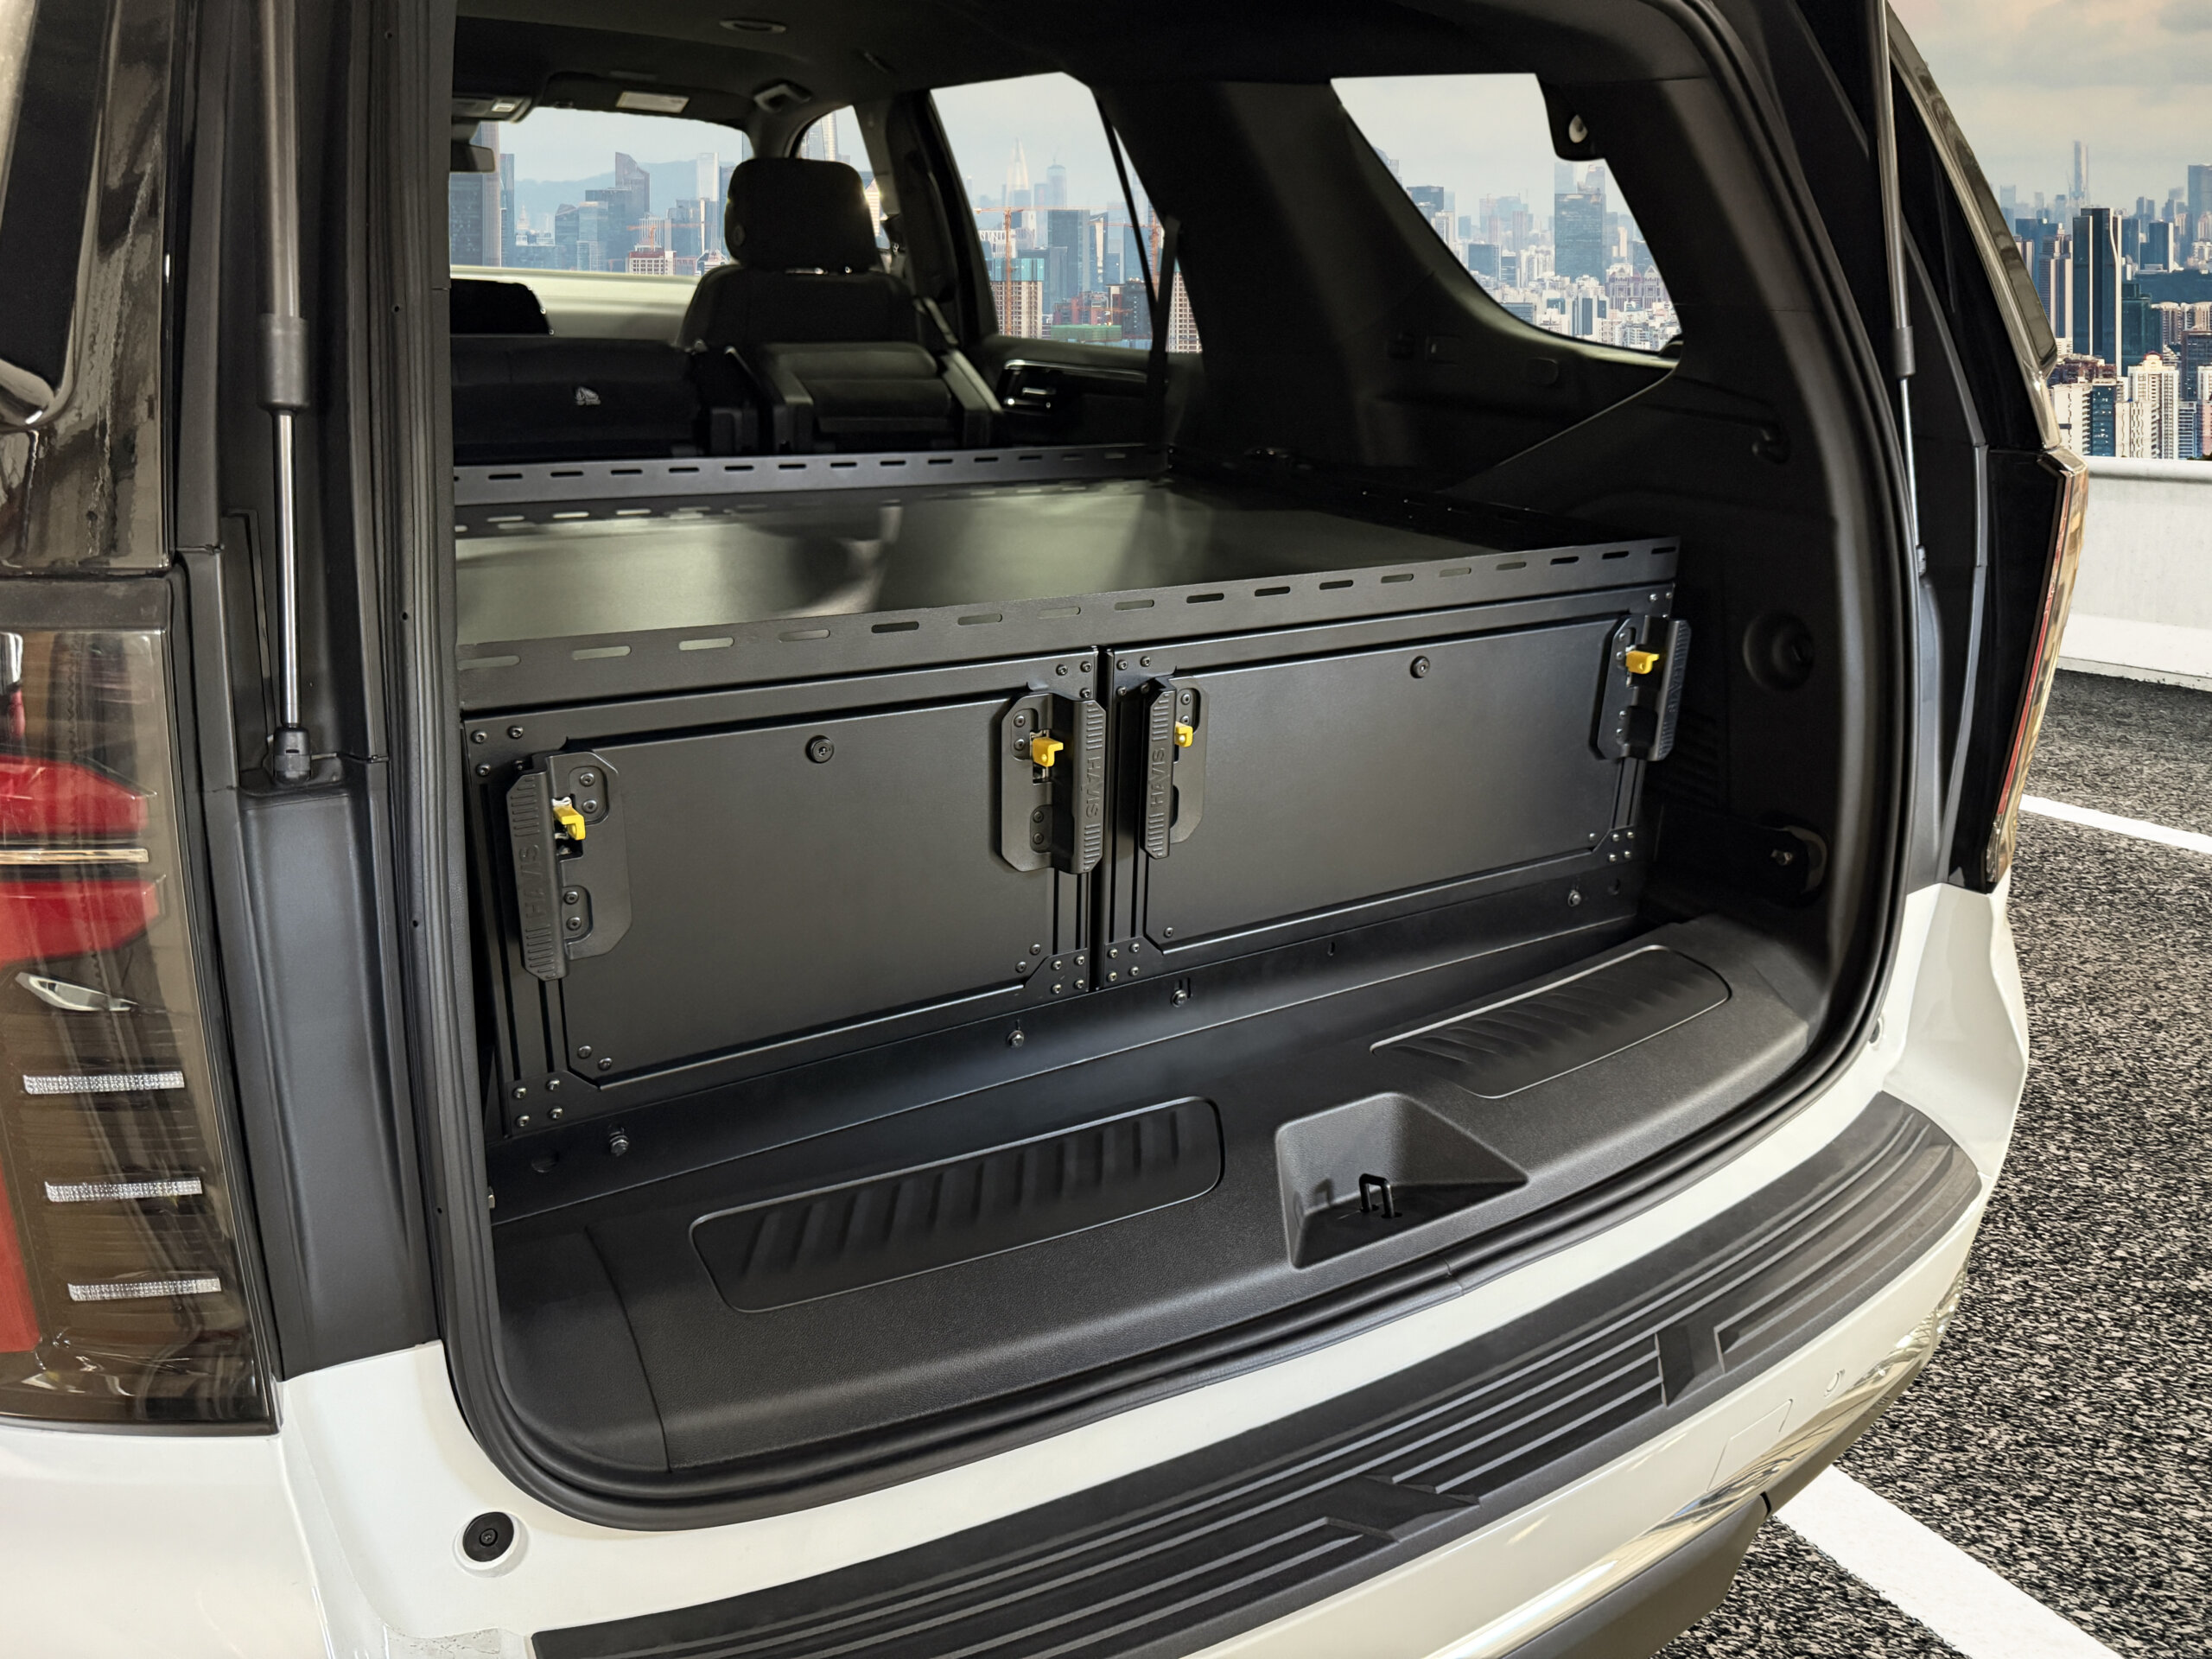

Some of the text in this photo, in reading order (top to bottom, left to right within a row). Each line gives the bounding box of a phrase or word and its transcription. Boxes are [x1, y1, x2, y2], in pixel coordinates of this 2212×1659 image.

[1086, 756, 1103, 818] HAVIS
[1150, 747, 1165, 807] HAVIS
[519, 844, 546, 919] HAVIS
